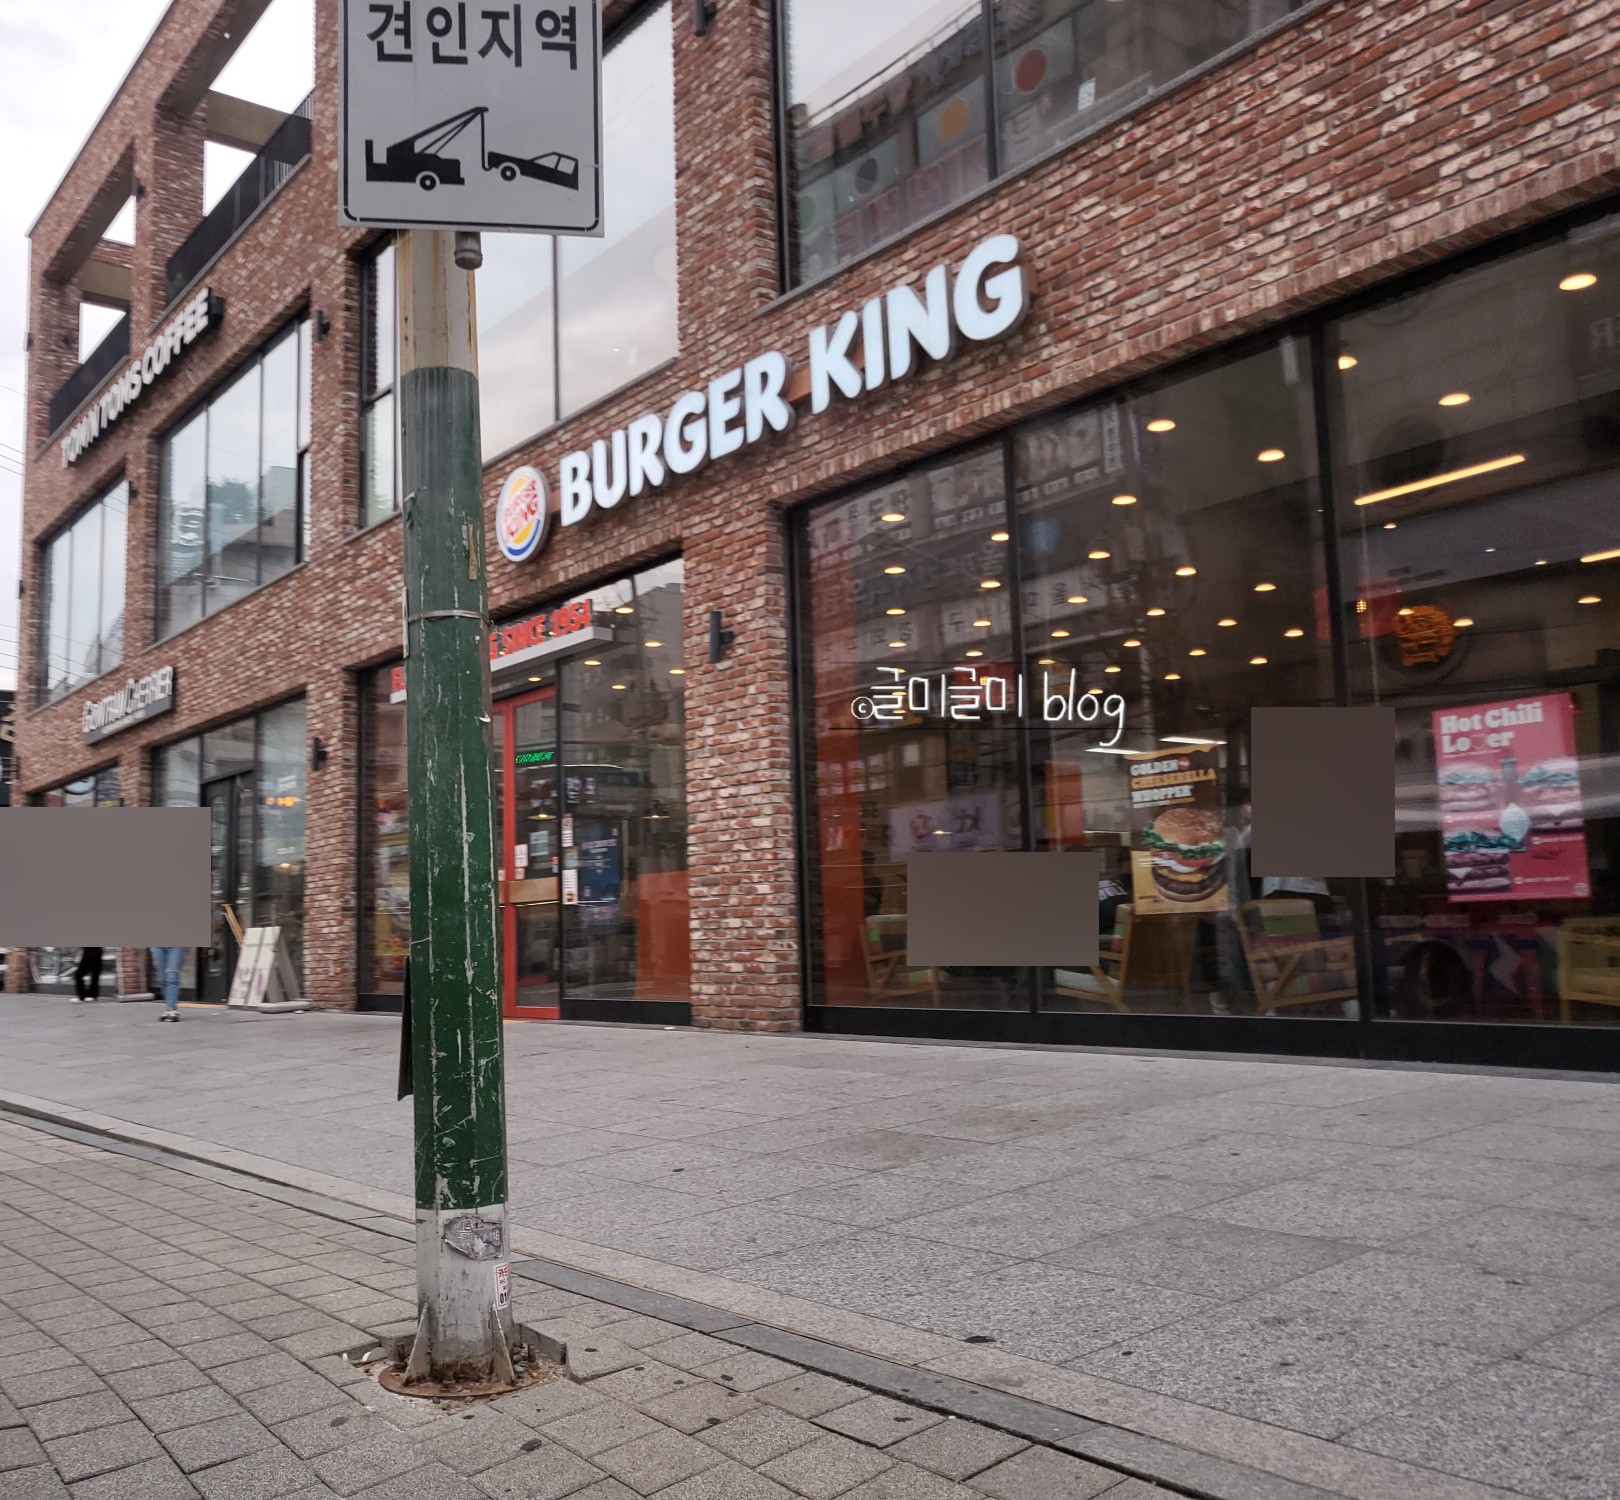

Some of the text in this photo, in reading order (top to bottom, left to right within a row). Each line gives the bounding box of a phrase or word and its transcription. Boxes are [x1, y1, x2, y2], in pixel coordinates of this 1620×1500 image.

[366, 1, 578, 70] 견인지역
[141, 286, 209, 385] COFFEE
[559, 350, 791, 527] BURGER
[809, 233, 1025, 415] KING
[503, 614, 545, 654] SINCE
[551, 598, 592, 637] 1954
[1440, 702, 1544, 734] Hot Chili
[1130, 759, 1179, 776] GOLDEN
